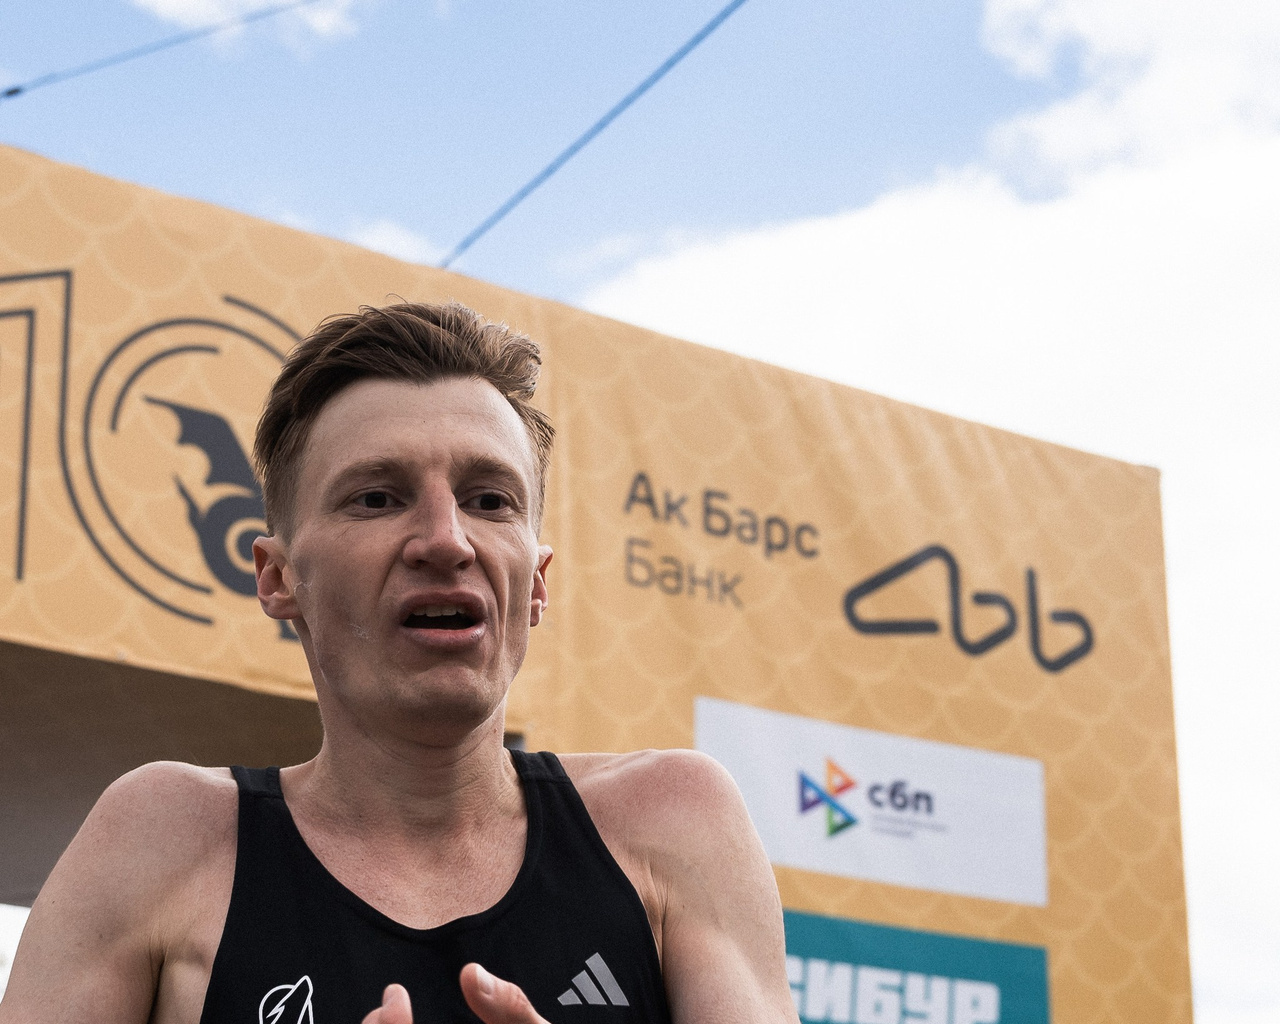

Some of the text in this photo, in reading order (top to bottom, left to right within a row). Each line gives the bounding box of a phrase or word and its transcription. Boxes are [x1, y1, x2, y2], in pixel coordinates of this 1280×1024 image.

[624, 471, 820, 560] Ак Барс
[624, 538, 745, 608] Банк
